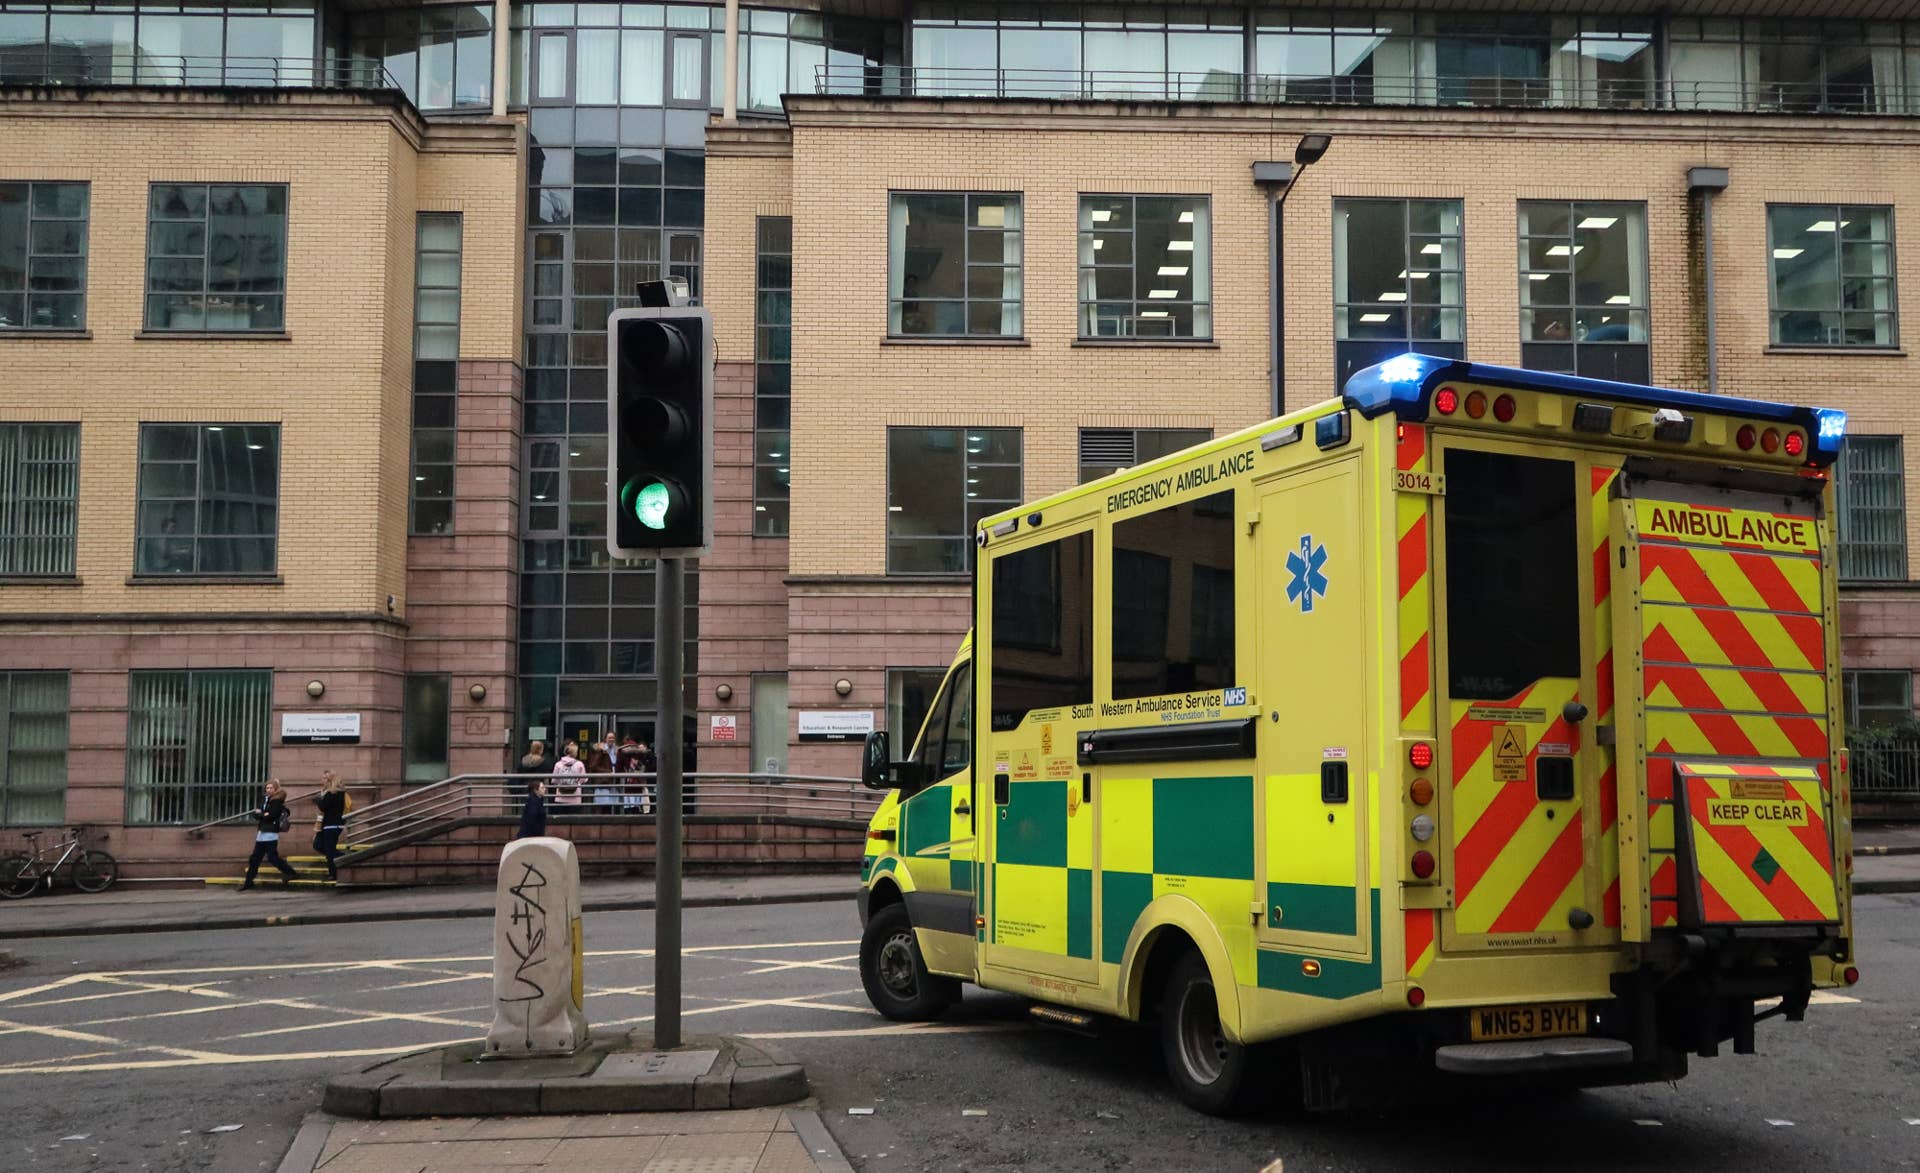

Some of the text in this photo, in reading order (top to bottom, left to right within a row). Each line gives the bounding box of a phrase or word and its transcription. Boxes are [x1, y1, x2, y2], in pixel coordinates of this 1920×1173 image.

[1107, 450, 1254, 514] EMERGENCY AMBULANCE
[1398, 473, 1431, 490] 3014
[1651, 508, 1807, 546] AMBULANCE
[1072, 705, 1094, 720] South
[1101, 701, 1133, 717] Western
[1135, 696, 1183, 713] Ambulance
[1185, 693, 1221, 709] Service
[1224, 687, 1246, 706] NHS
[1161, 708, 1221, 721] NHS Foundation Trust
[1713, 804, 1803, 820] KEEP CLEAR
[1481, 1007, 1579, 1036] WN63 BYH
